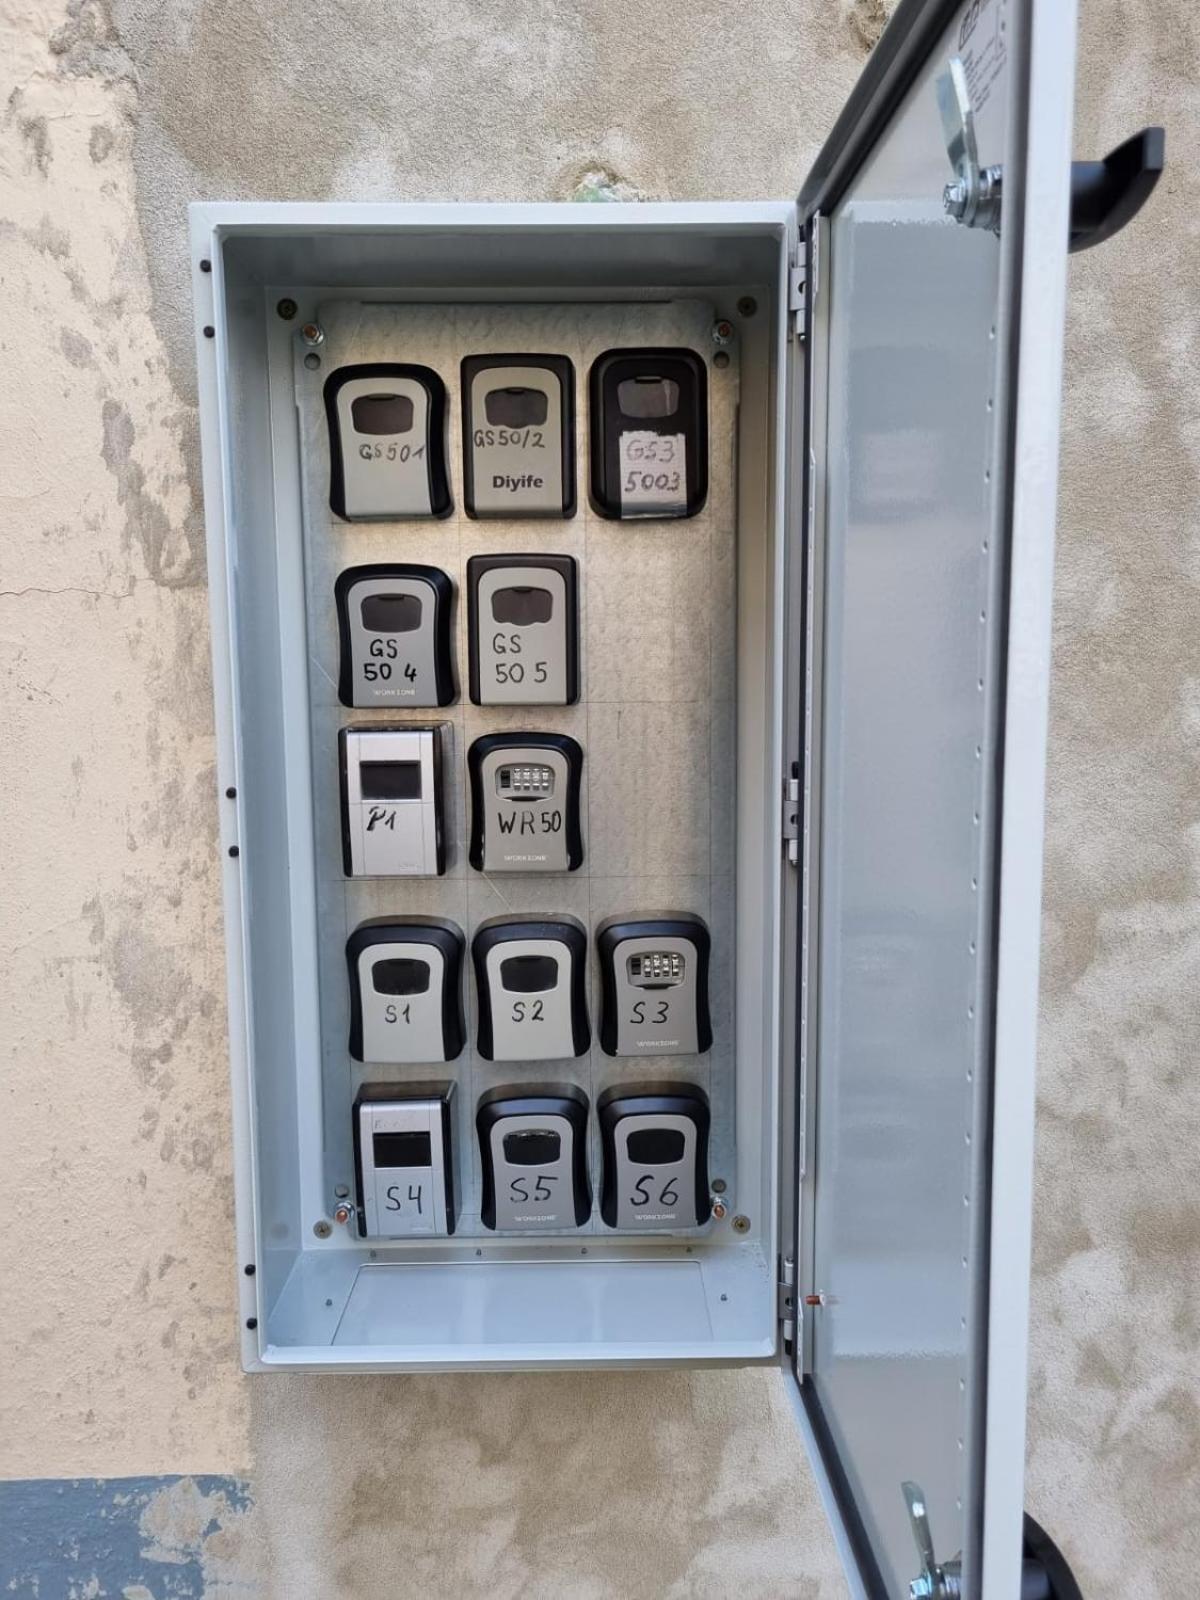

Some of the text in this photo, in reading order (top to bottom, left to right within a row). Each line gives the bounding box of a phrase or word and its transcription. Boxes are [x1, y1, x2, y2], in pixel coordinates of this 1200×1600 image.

[492, 474, 544, 490] Diyife
[369, 638, 398, 660] GS
[492, 633, 521, 655] GS
[384, 1003, 411, 1024] S1
[386, 1185, 423, 1215] S4
[509, 1176, 558, 1203] S5
[629, 1174, 679, 1206] S6
